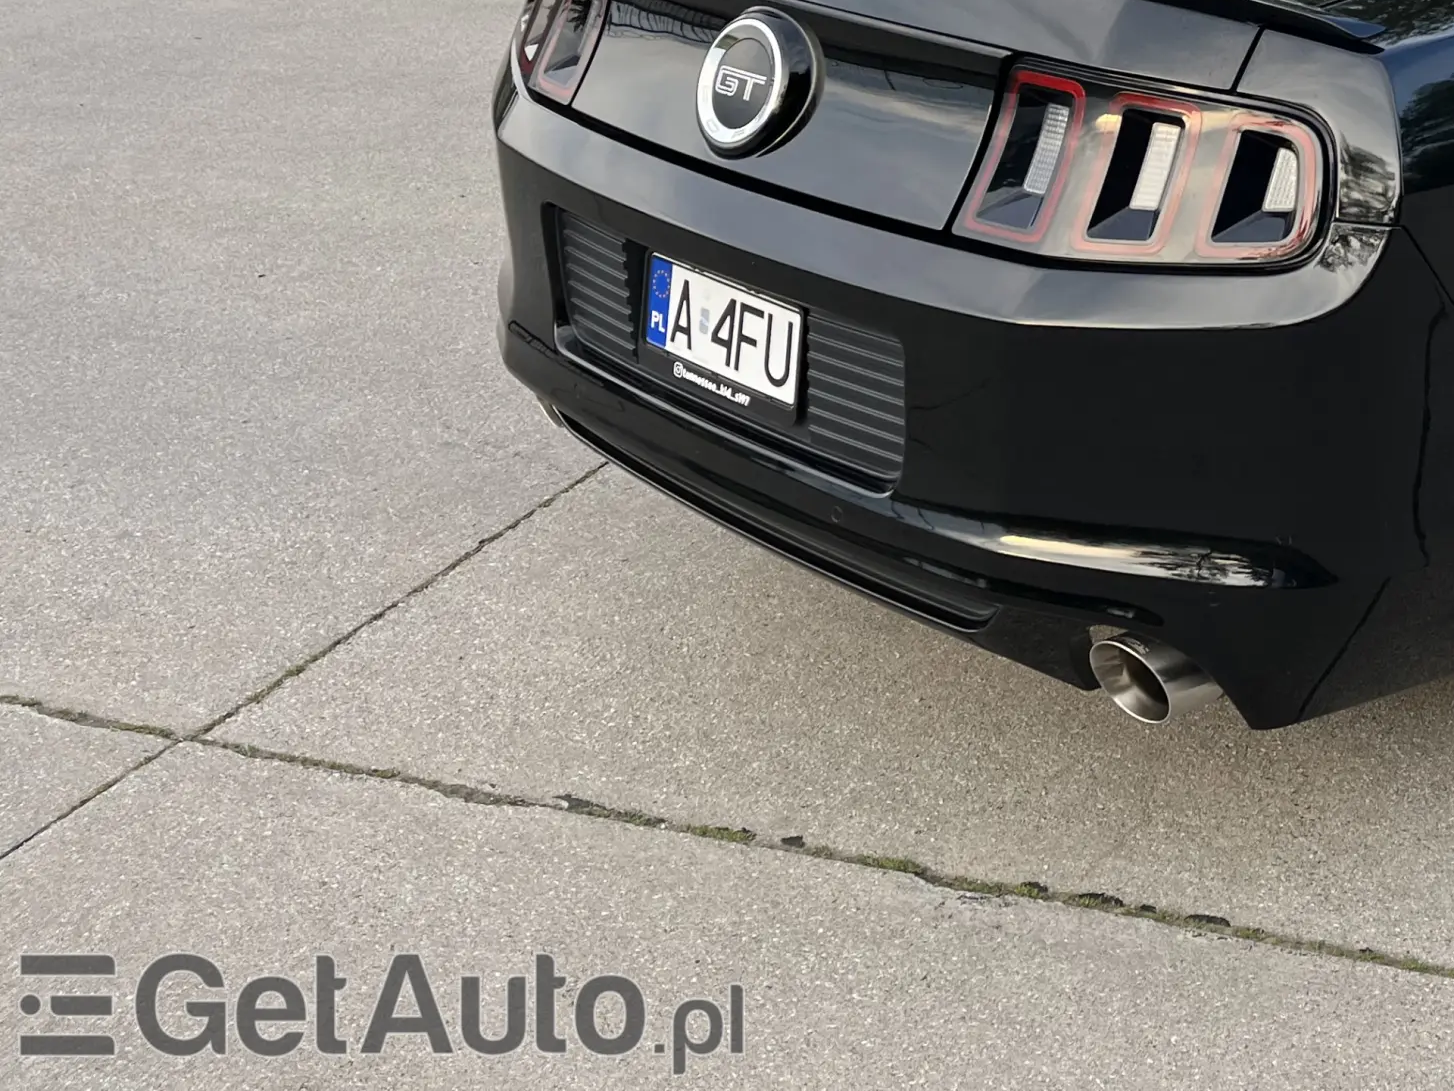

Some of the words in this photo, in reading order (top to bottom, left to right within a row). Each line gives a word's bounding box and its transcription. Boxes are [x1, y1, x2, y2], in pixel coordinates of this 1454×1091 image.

[715, 64, 768, 102] GT
[650, 310, 665, 334] PL
[670, 279, 692, 350] A
[711, 298, 793, 387] 4FU
